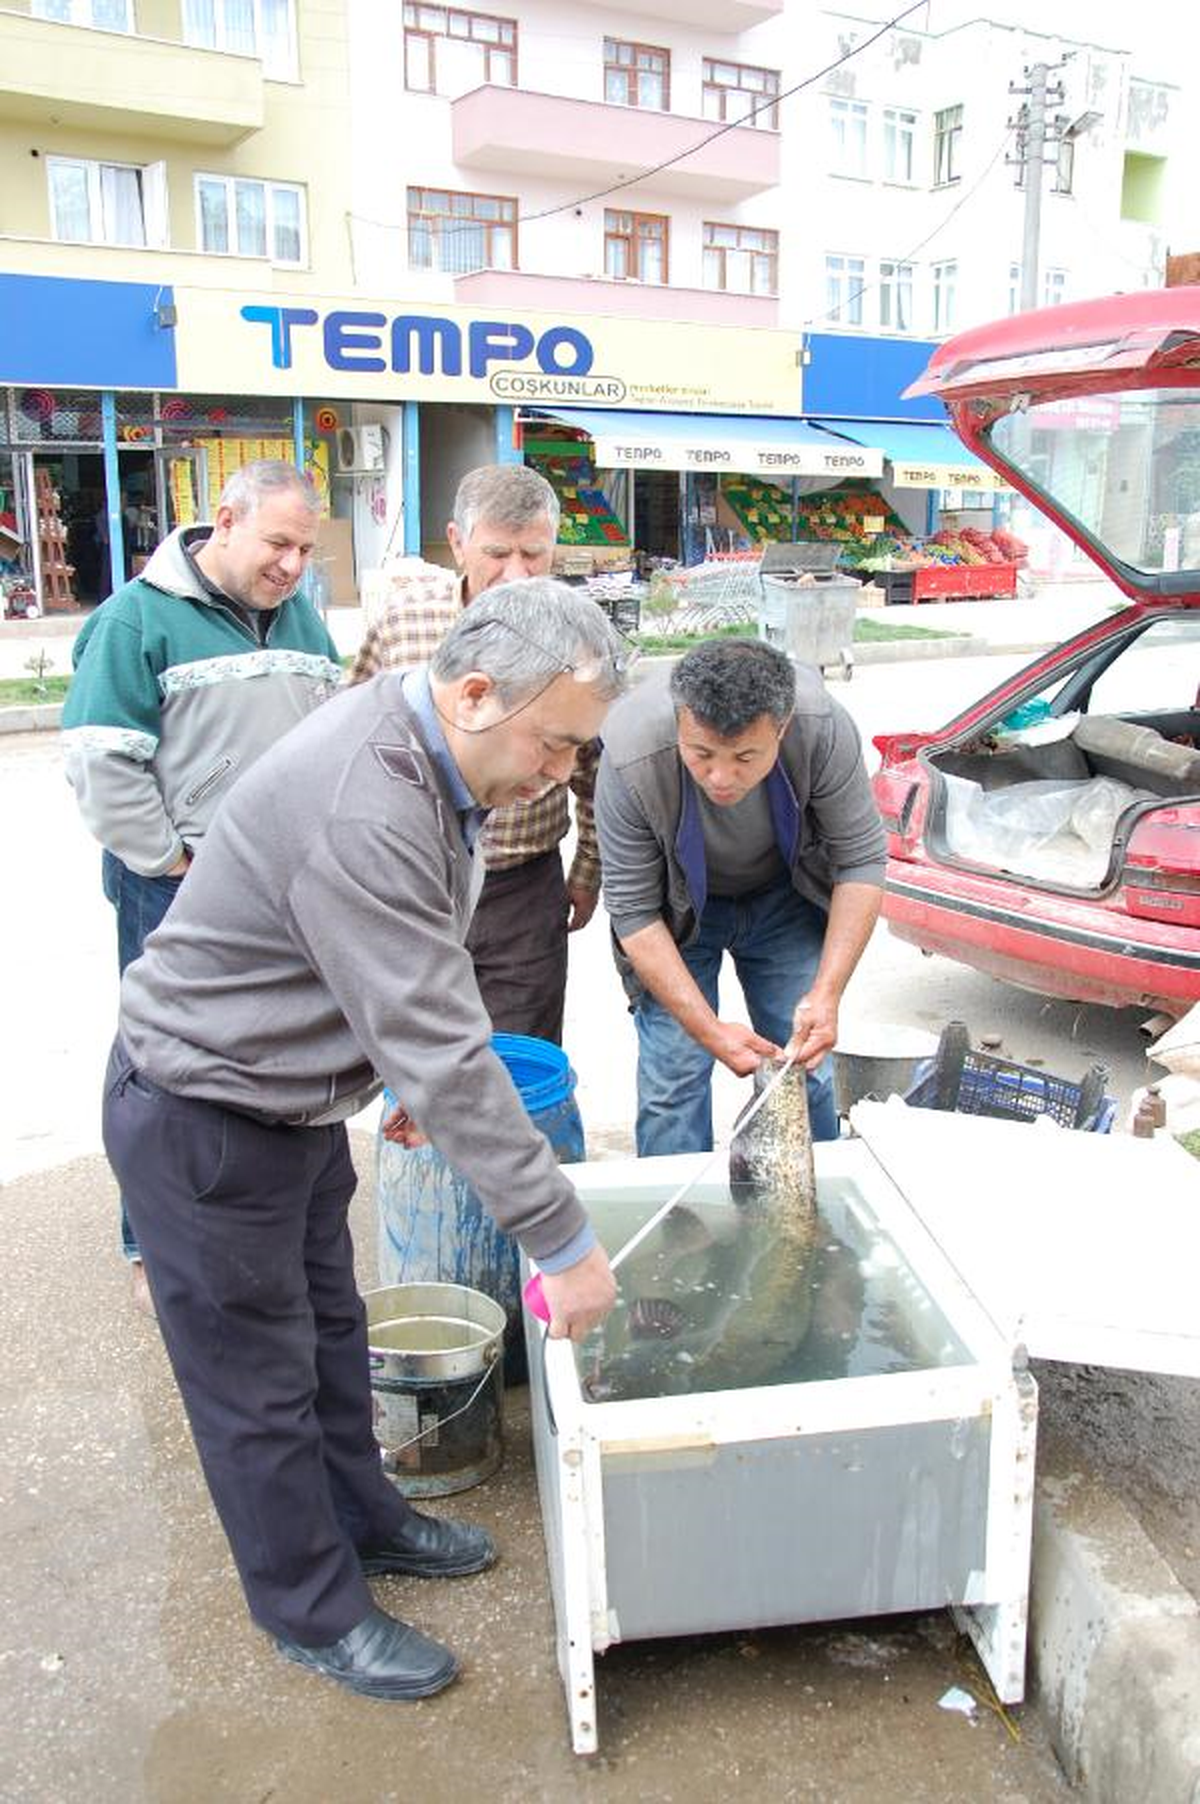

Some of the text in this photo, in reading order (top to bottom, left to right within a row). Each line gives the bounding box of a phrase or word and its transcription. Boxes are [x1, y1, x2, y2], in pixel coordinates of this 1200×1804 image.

[240, 305, 594, 378] TEMPO
[495, 377, 620, 397] COŞKUNLAR
[614, 446, 864, 467] TEMPO TEMPO TEMPO TEMPO
[903, 470, 936, 481] TEMPO
